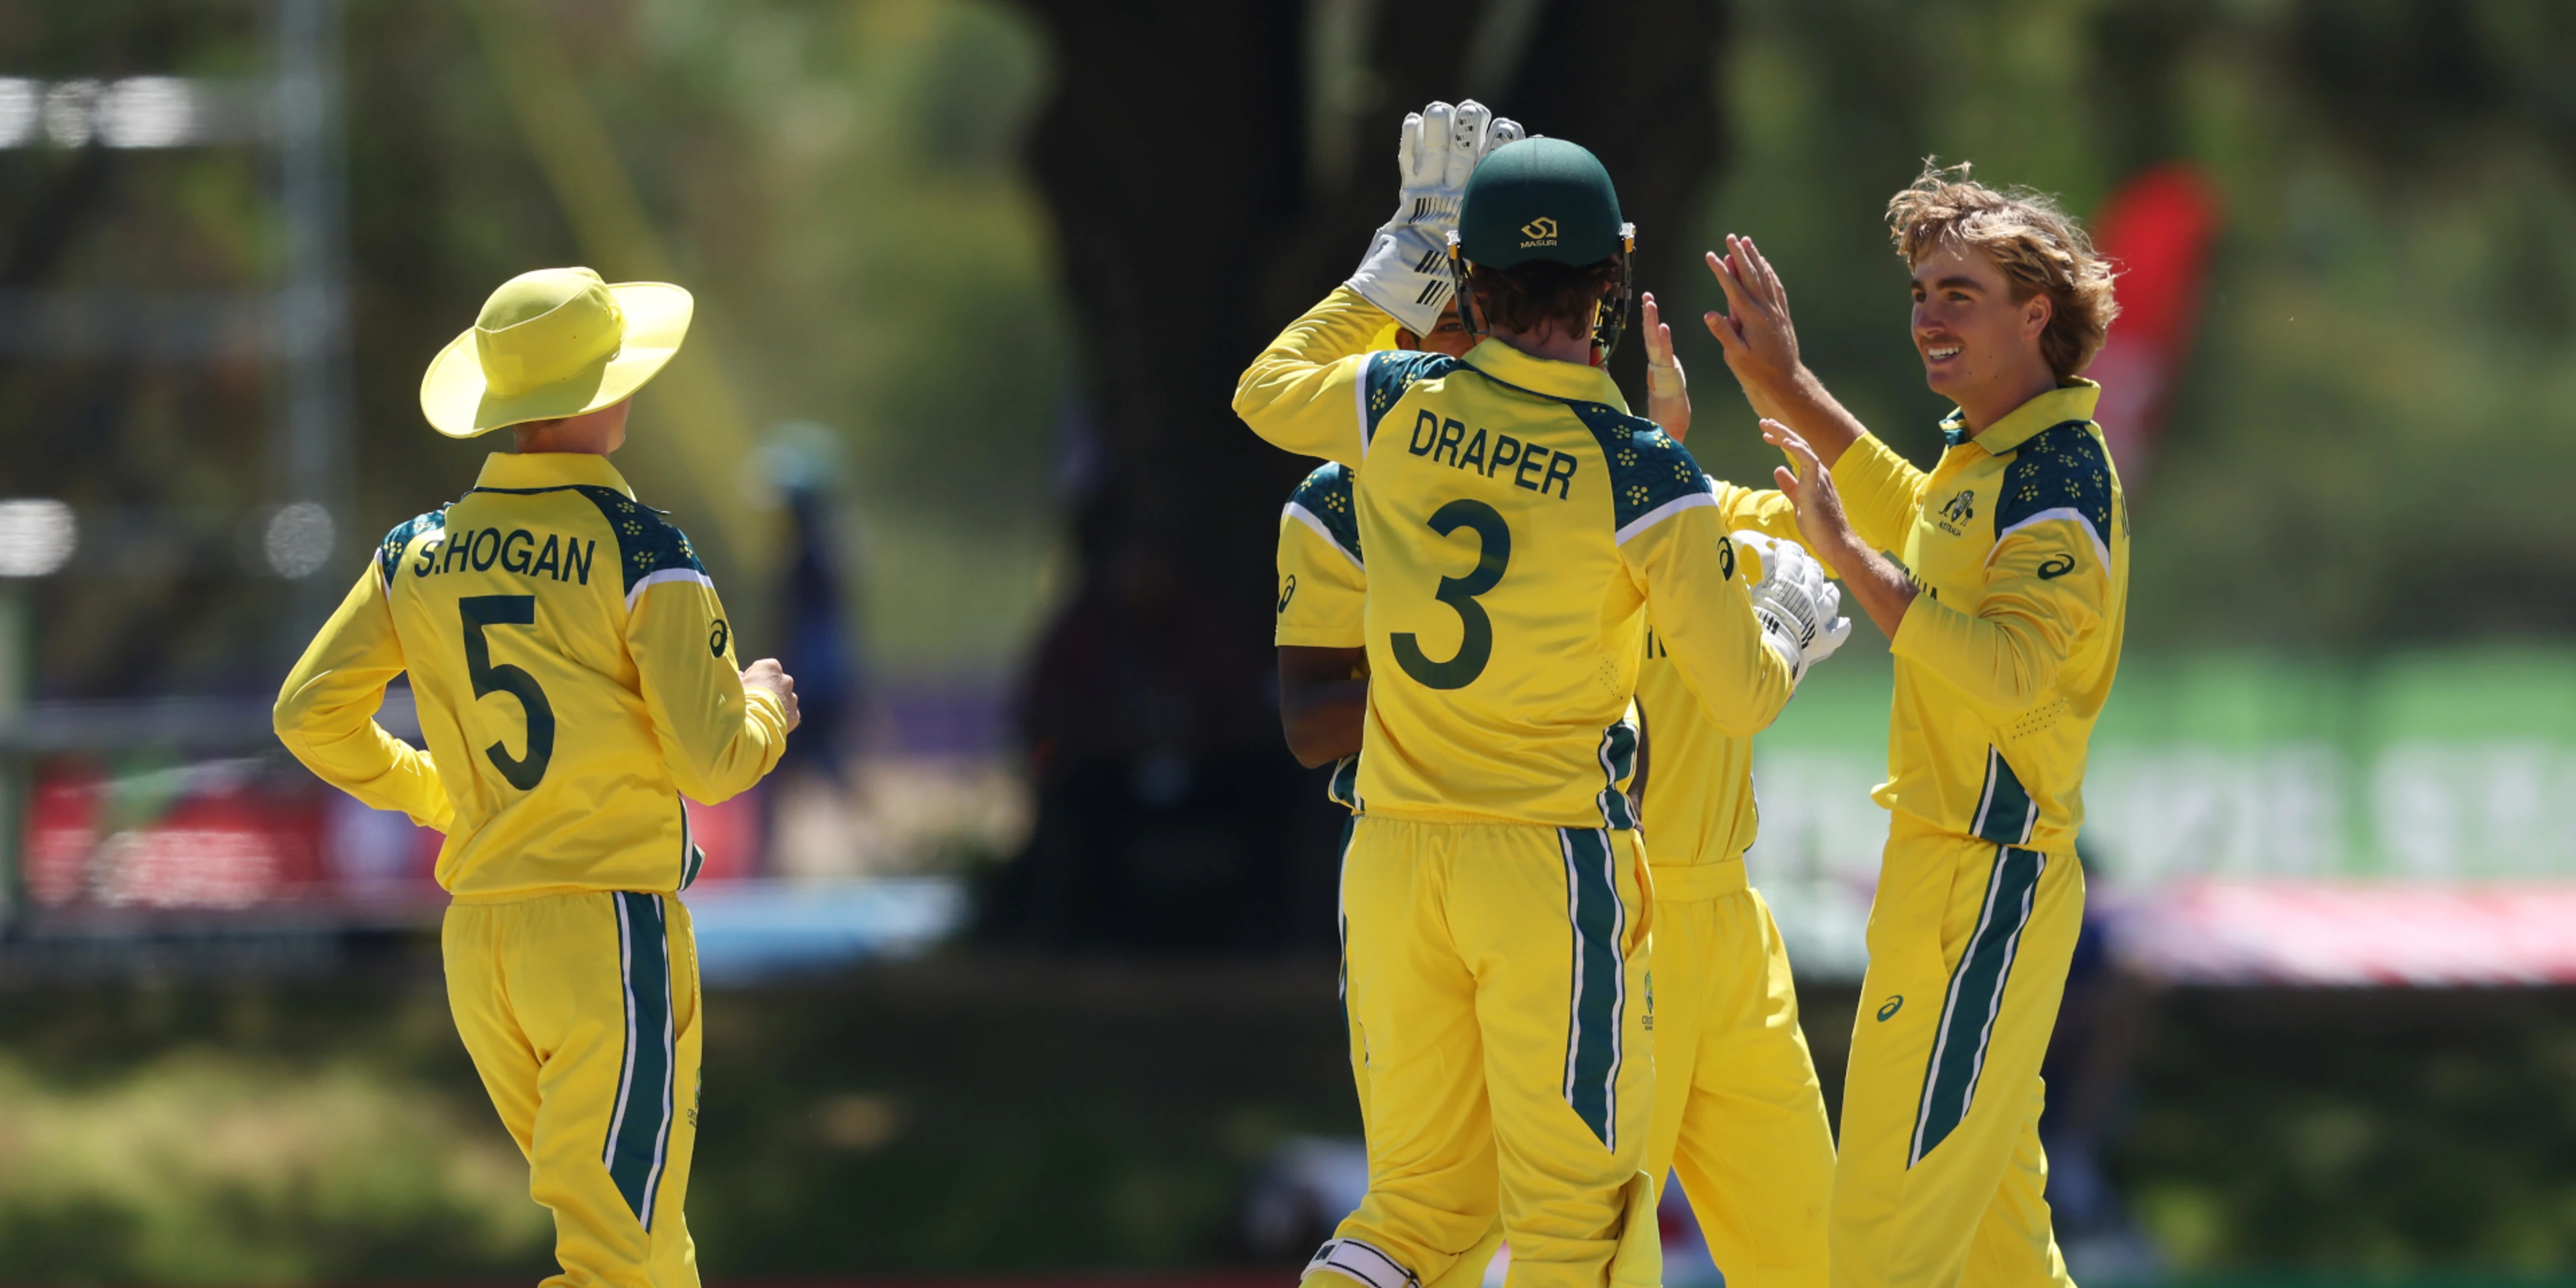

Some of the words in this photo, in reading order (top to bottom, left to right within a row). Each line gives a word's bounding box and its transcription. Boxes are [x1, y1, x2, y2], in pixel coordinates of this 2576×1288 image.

[1520, 239, 1557, 249] MASURI
[1409, 409, 1578, 500] DRAPER
[413, 527, 596, 586] S.HOGAN
[1391, 498, 1511, 690] 3
[459, 594, 555, 791] 5
